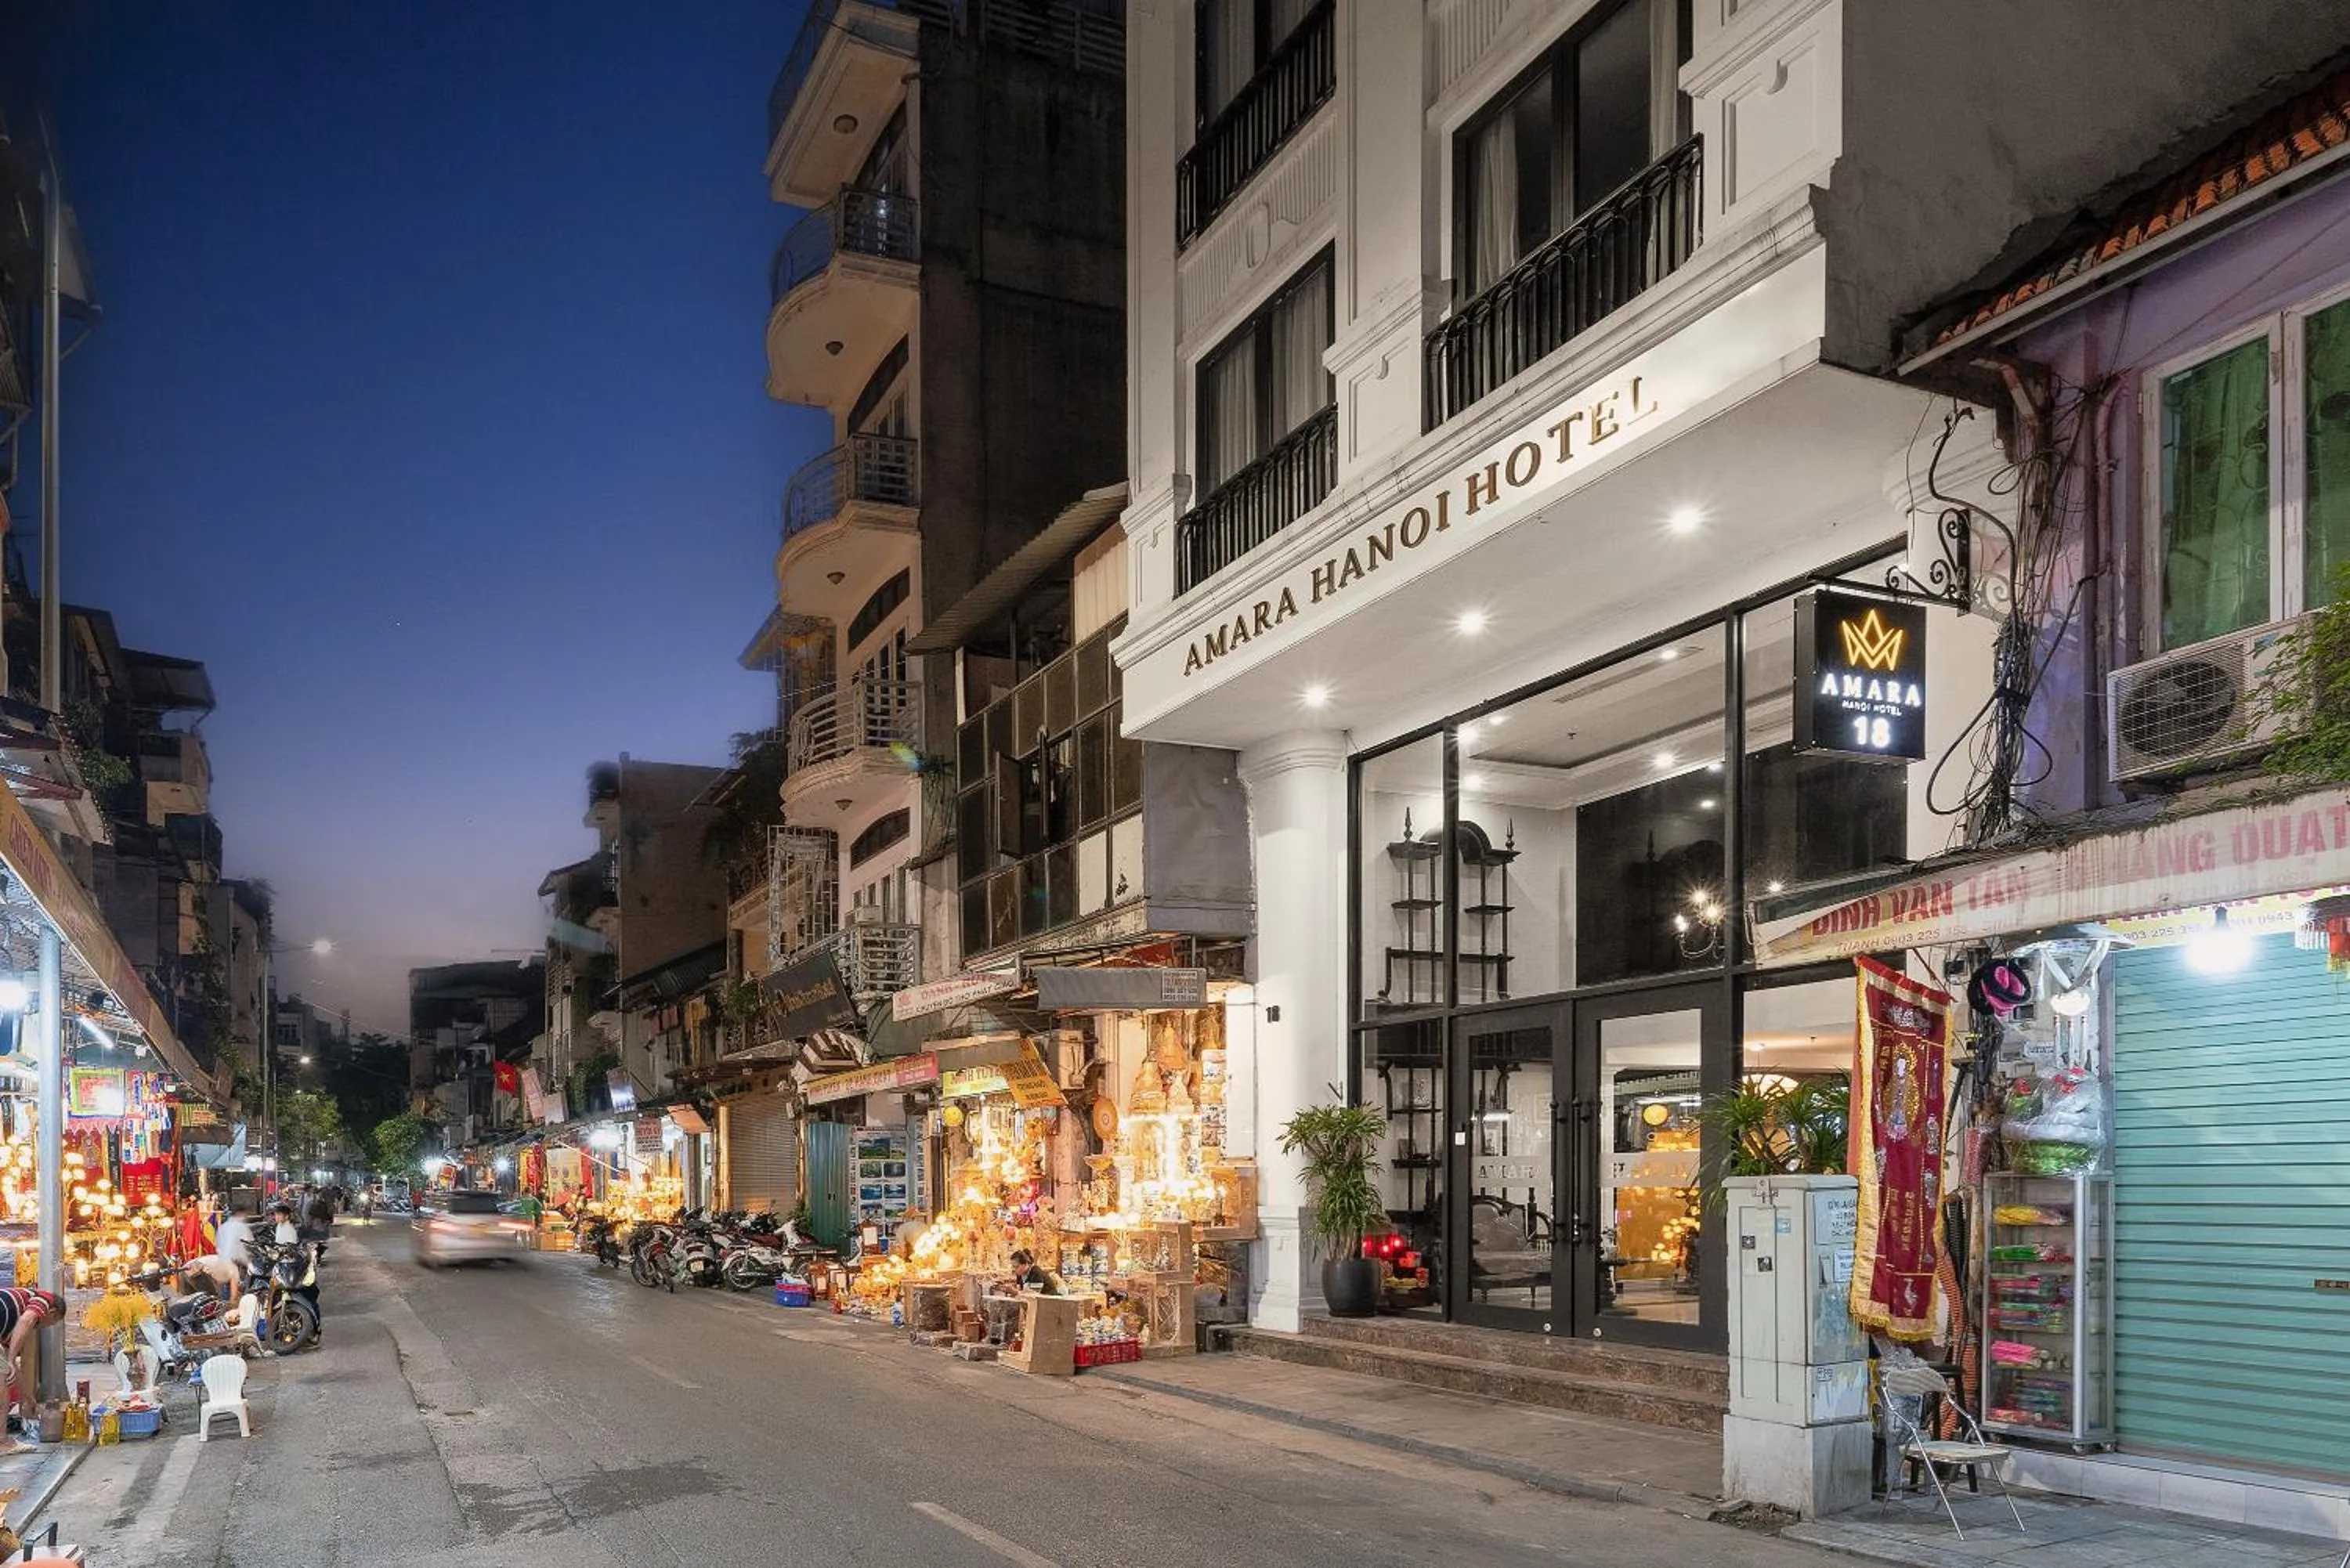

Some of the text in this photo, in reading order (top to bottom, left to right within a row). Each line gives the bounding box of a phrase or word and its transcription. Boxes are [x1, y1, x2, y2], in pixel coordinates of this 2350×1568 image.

[1184, 375, 1658, 676] AMARA HANOI HOTEL
[1820, 672, 1922, 708] AMARA
[1842, 700, 1903, 717] HANOI HOTEL
[1853, 716, 1891, 749] 18
[1266, 1006, 1281, 1023] 18
